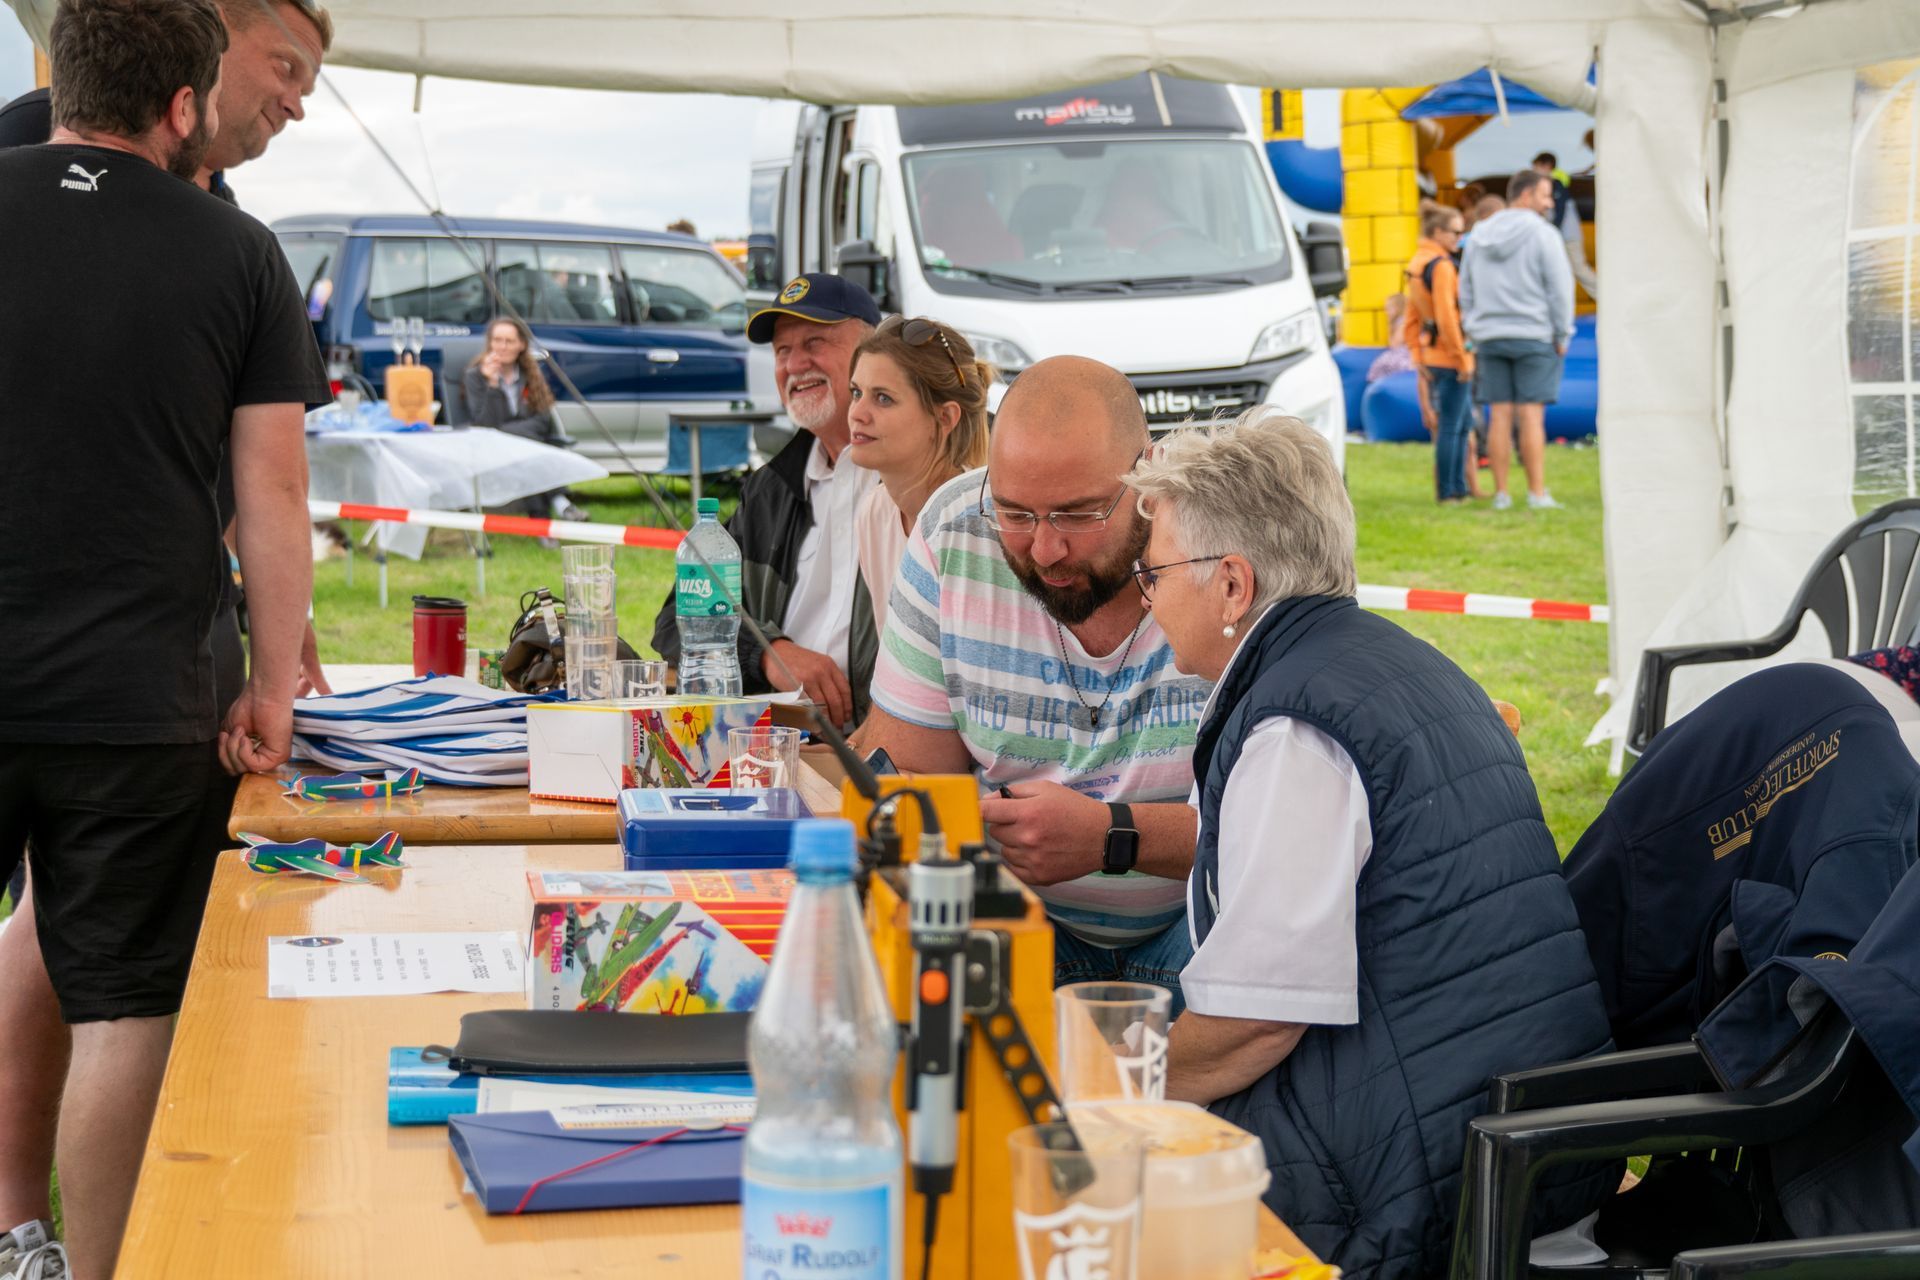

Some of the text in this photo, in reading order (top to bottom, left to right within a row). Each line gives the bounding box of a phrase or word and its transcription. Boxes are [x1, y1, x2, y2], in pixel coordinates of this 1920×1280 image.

[1015, 99, 1133, 121] malibu
[61, 178, 92, 192] PUMA
[679, 578, 713, 598] VILSA
[632, 715, 640, 757] GLIDERS
[550, 911, 563, 974] GLIDERS
